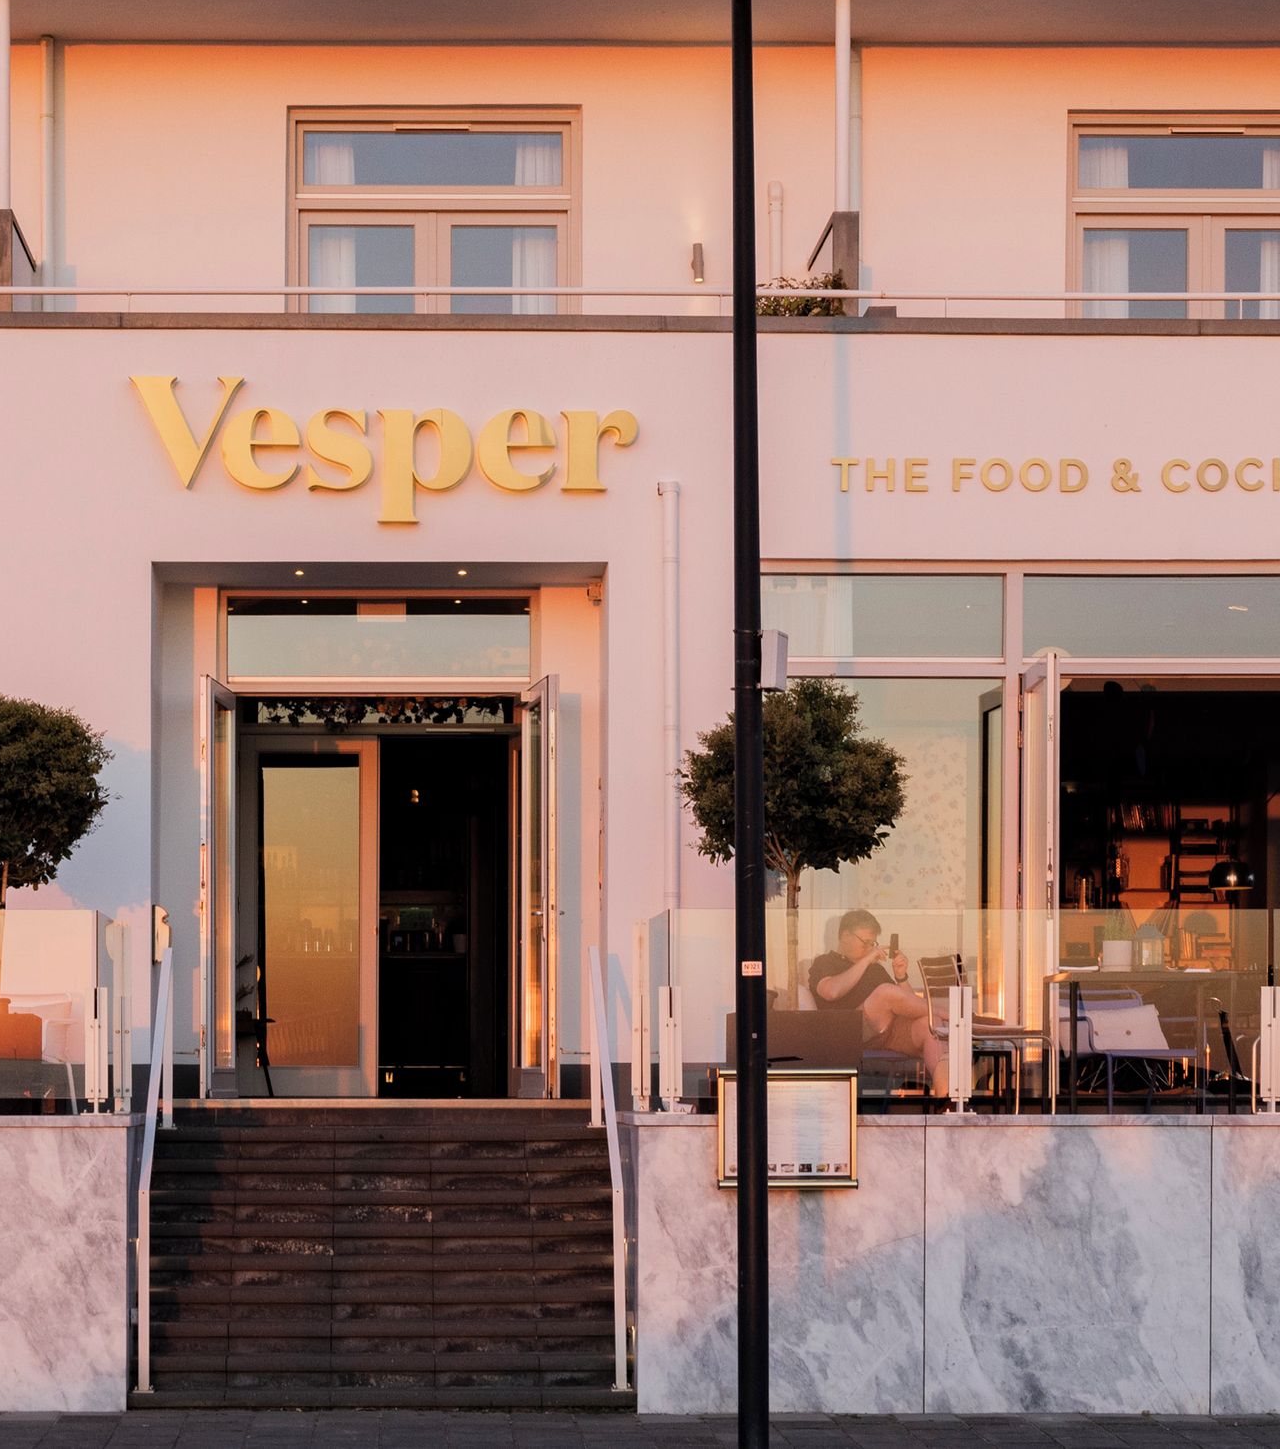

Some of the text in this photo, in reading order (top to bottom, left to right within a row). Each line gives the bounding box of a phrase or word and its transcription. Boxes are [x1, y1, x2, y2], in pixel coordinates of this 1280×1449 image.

[128, 375, 639, 525] Vesper
[830, 457, 929, 493] THE
[951, 457, 1090, 494] FOOD
[1110, 457, 1142, 493] &
